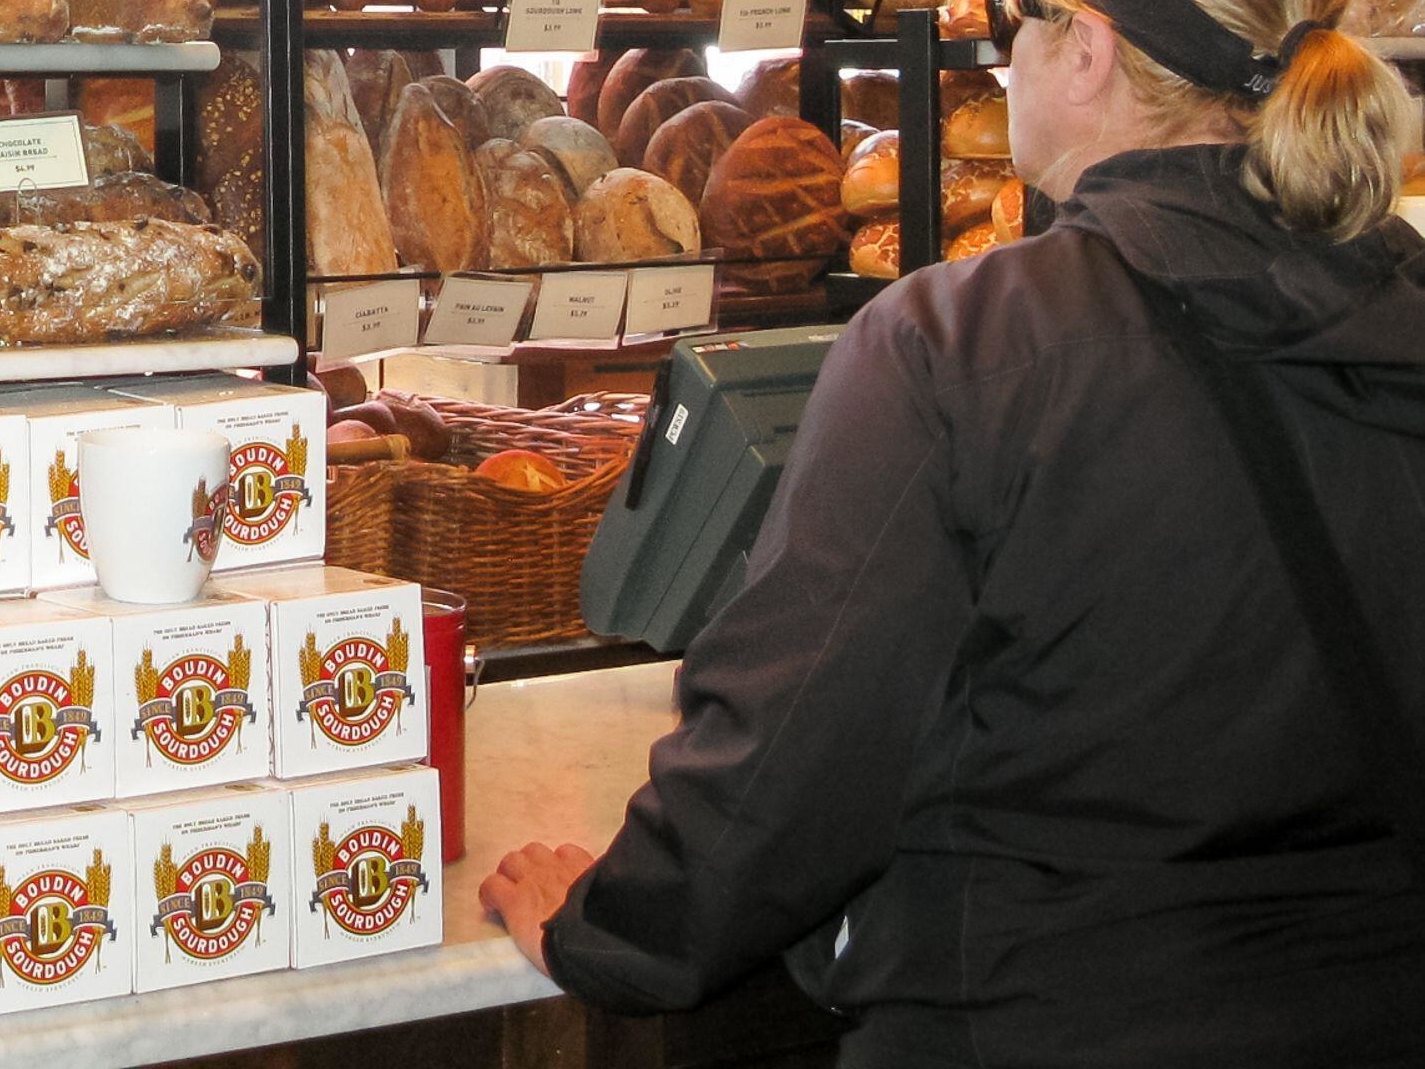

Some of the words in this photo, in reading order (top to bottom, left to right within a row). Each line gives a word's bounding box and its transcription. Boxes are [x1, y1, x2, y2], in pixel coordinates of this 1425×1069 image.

[22, 147, 49, 157] BREAD
[15, 164, 35, 173] $4.99
[355, 306, 389, 319] CIABATTA
[454, 302, 471, 311] PAIN
[568, 295, 595, 304] WALNUT
[324, 643, 386, 674] BOUDIN
[161, 660, 226, 691] BOUDIN
[0, 676, 68, 708] BOUDIN
[317, 696, 394, 740] SOURDOUGH
[154, 715, 234, 759] SOURDOUGH
[338, 831, 400, 863] BOUDIN
[180, 854, 245, 886] BOUDIN
[14, 876, 85, 908] BOUDIN
[331, 884, 408, 929] SOURDOUGH
[173, 907, 254, 953] SOURDOUGH
[6, 931, 94, 979] SOURDOUGH
